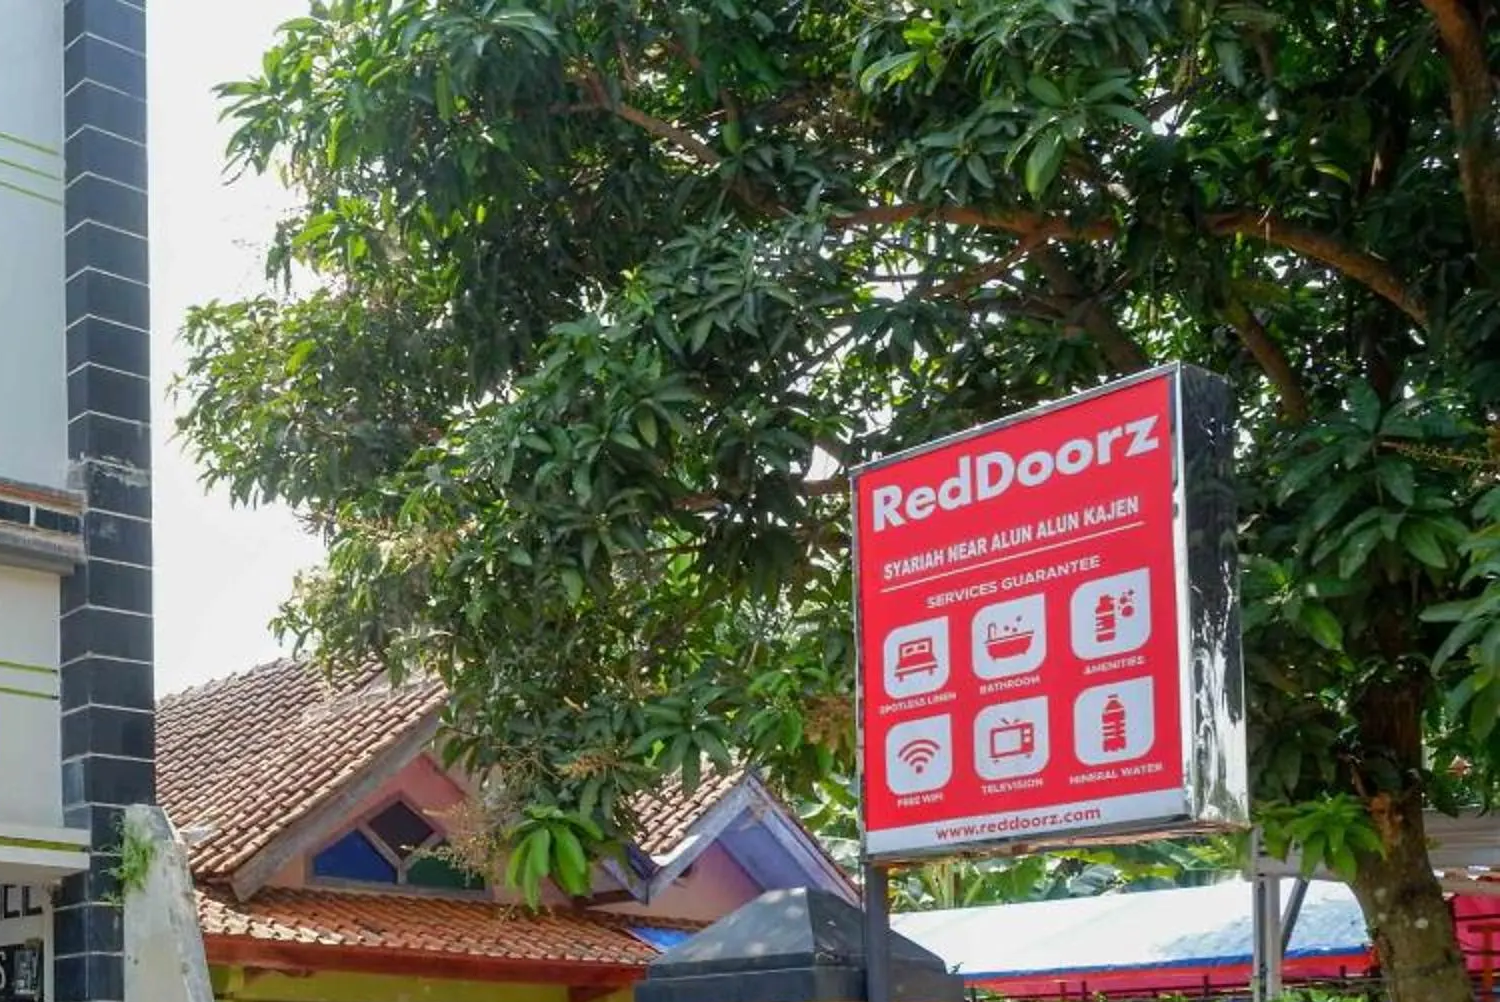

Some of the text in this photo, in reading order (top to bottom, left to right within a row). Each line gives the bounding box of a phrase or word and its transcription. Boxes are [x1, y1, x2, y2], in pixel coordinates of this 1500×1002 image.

[872, 415, 1159, 532] RedDoorz
[883, 496, 1139, 580] SYARIAH NEAR ALUN ALUN KAJEN
[927, 555, 1101, 608] SERVICES GUARANTEE
[1083, 655, 1146, 676] AMENITIES
[979, 675, 1041, 695] BATHROOM
[980, 777, 1044, 796] TELEVISION
[1069, 761, 1164, 785] MINERAL WATER
[935, 807, 1101, 841] www.reddoorz.com
